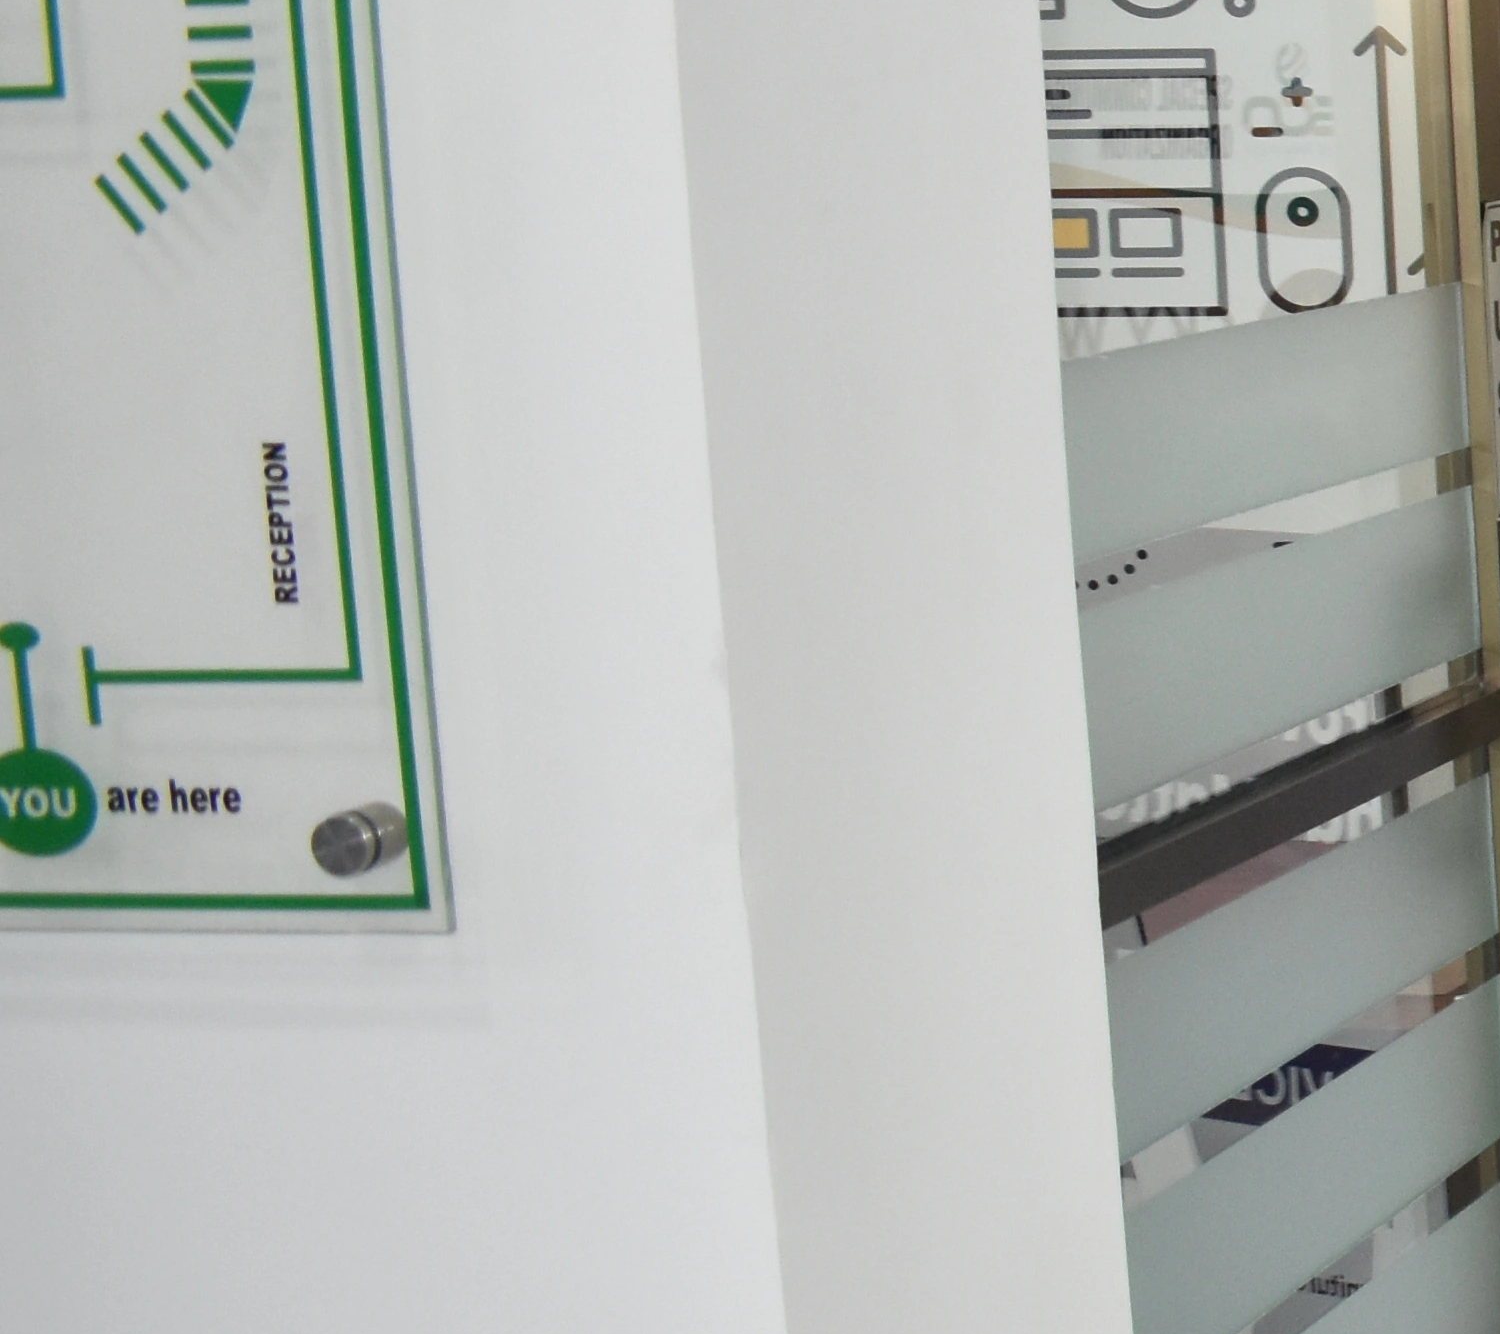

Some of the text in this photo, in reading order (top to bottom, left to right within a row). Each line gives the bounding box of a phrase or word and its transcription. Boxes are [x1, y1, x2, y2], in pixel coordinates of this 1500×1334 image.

[262, 441, 299, 605] RECEPTION
[0, 779, 241, 819] YOU are here
